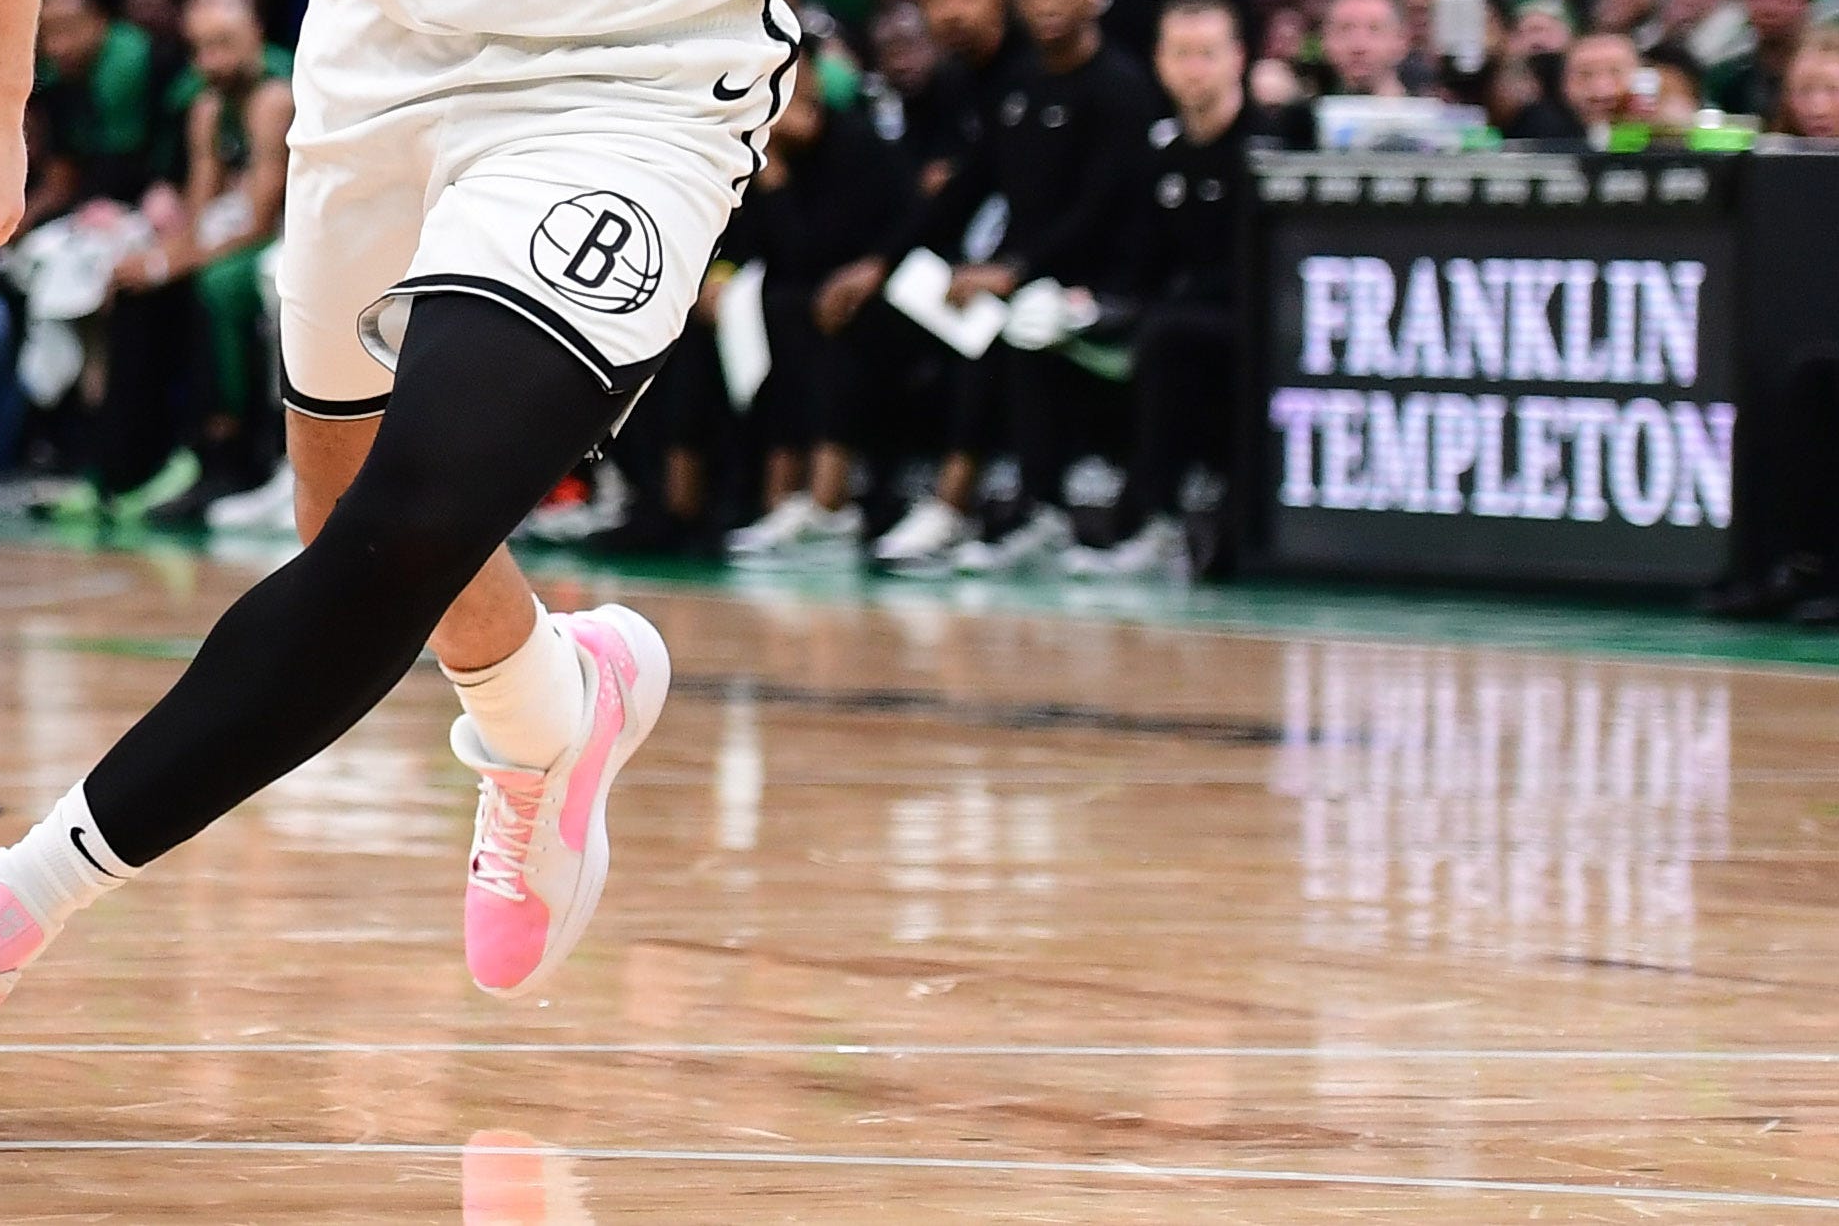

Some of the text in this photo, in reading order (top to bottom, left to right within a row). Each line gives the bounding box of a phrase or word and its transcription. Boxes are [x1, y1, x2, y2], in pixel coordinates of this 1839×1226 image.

[562, 209, 632, 289] B
[1298, 255, 1707, 387] FRANKLIN
[1268, 386, 1738, 529] TEMPLETON
